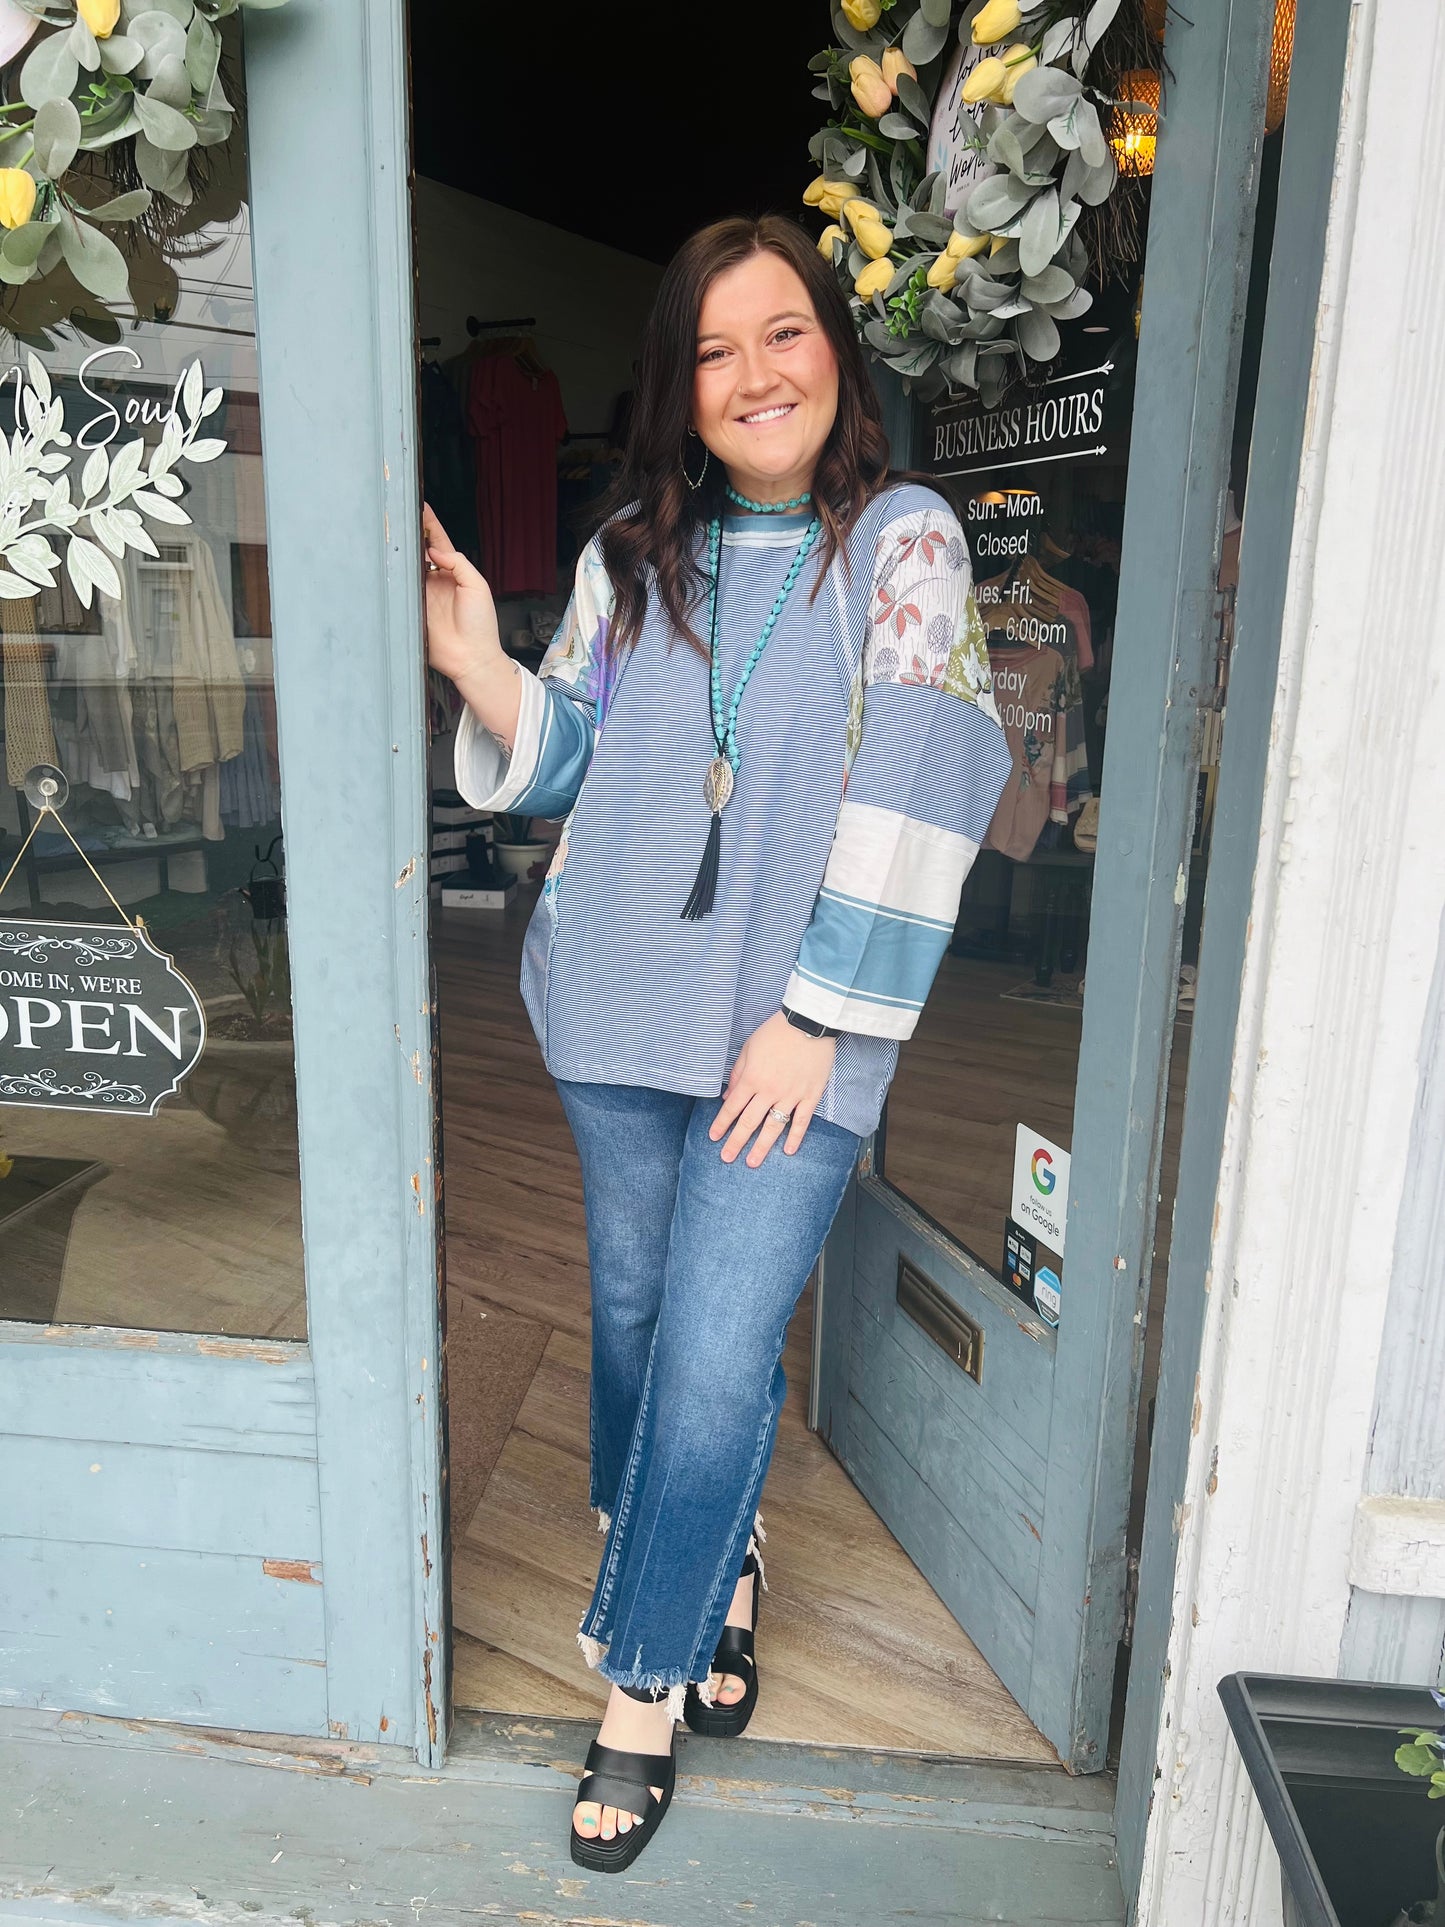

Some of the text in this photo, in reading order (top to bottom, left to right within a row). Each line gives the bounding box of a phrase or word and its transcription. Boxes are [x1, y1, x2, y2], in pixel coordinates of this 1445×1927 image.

[933, 388, 1104, 461] BUSINESS HOURS
[976, 529, 1029, 556] Closed
[974, 579, 1033, 604] ues.-Fri.
[1006, 617, 1067, 650] 6:00pm
[0, 970, 143, 995] OME IN, WE'RE
[0, 996, 188, 1060] PEN
[1021, 1203, 1031, 1216] on
[1032, 1209, 1060, 1237] Google
[1041, 1286, 1057, 1308] ring
